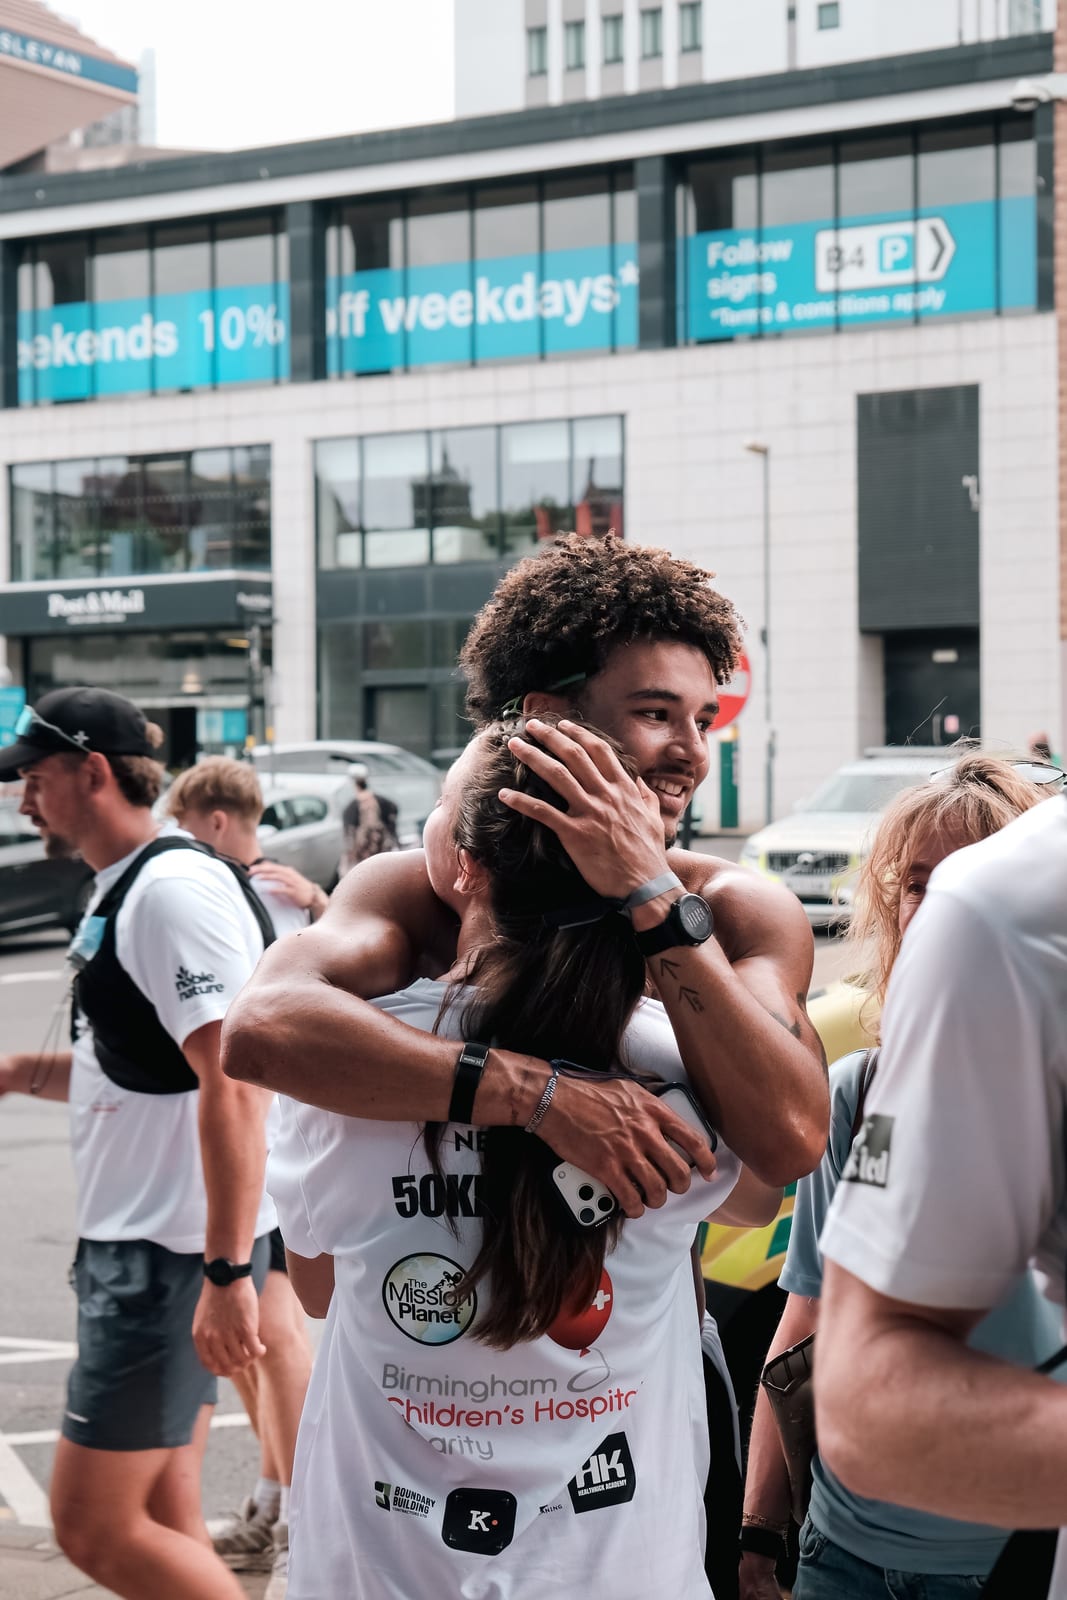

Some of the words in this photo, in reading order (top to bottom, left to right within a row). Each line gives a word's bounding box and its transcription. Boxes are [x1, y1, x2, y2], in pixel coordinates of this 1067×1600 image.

[706, 238, 793, 268] Follow
[826, 245, 865, 273] B4
[707, 271, 777, 303] signs
[792, 292, 890, 321] conditions
[893, 286, 946, 313] apply
[198, 305, 286, 353] 10%
[175, 971, 215, 992] noble
[179, 983, 224, 1003] nature
[408, 1278, 428, 1289] The
[398, 1302, 464, 1324] Planet
[382, 1363, 558, 1403] Birmingham
[575, 1449, 626, 1489] HK
[394, 1485, 436, 1509] BOUNDARY
[605, 1478, 628, 1491] ACADEMY
[393, 1496, 430, 1515] BUILDING
